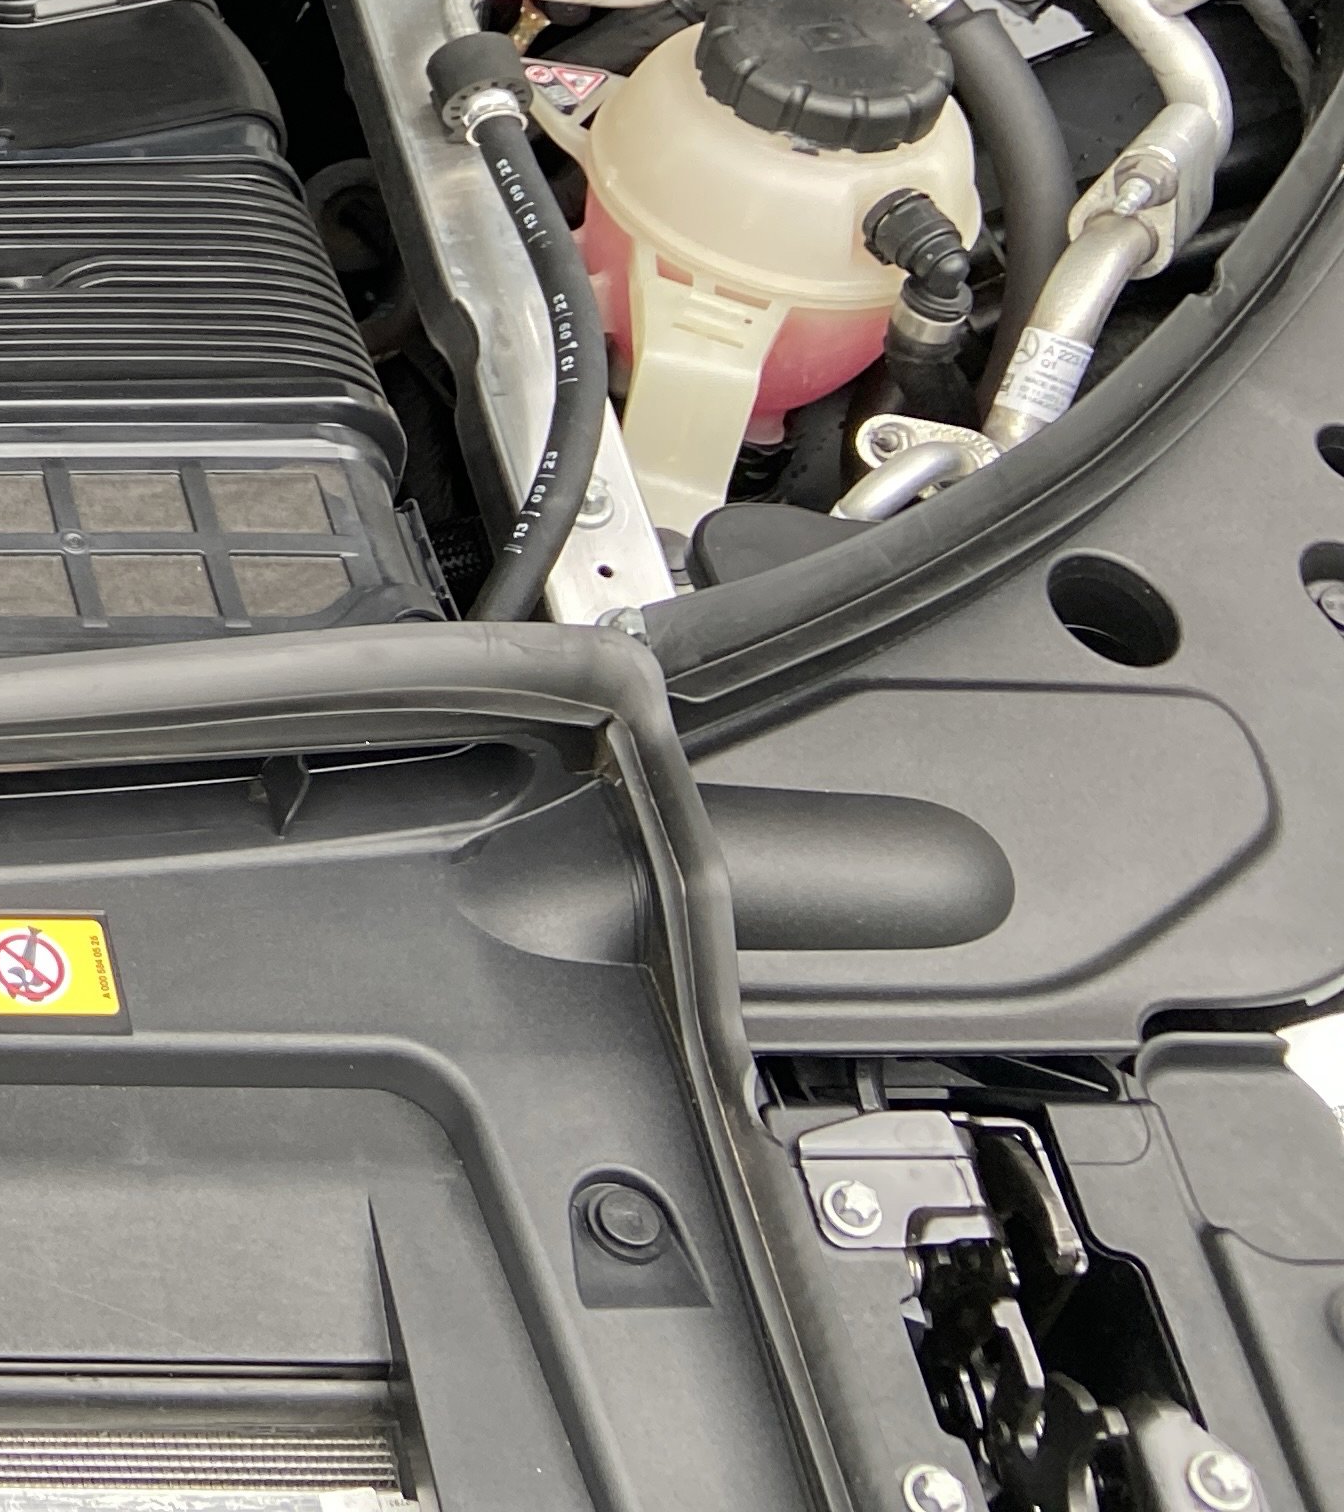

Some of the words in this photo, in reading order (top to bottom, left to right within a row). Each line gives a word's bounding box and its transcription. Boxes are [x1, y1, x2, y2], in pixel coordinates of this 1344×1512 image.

[496, 158, 513, 177] 23
[522, 213, 539, 229] 13
[552, 293, 569, 313] 23
[560, 355, 575, 372] 13
[513, 522, 530, 539] 13
[542, 450, 559, 470] 23
[99, 975, 110, 991] 000
